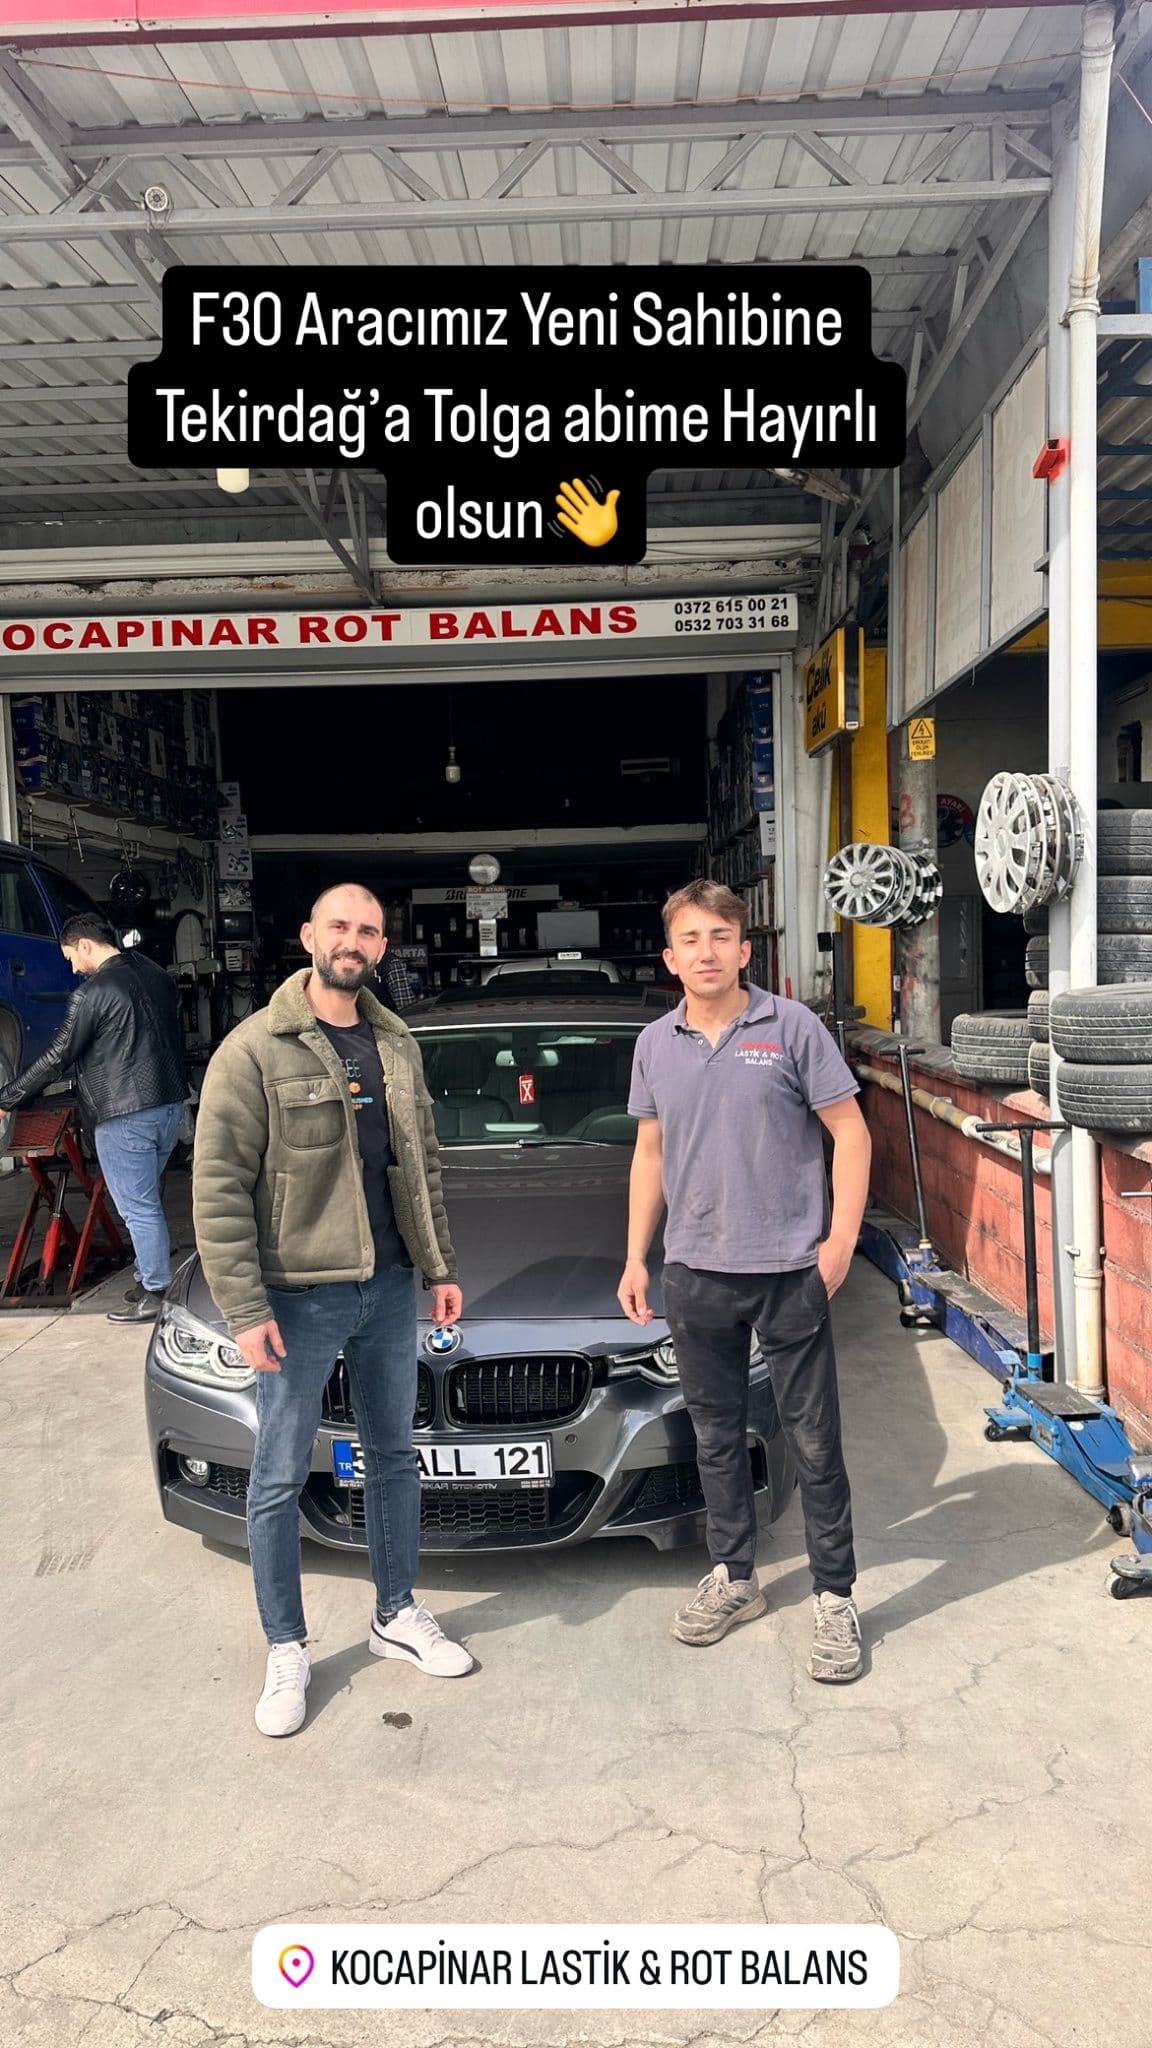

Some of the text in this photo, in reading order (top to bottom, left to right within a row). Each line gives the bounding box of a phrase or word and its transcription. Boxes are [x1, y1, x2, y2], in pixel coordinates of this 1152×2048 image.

[674, 597, 788, 615] 0372 615 00 21
[299, 613, 400, 643] ROT
[429, 605, 637, 639] BALANS
[675, 615, 789, 632] 0532 703 31 68
[338, 1462, 353, 1471] TR
[494, 1446, 544, 1475] 121
